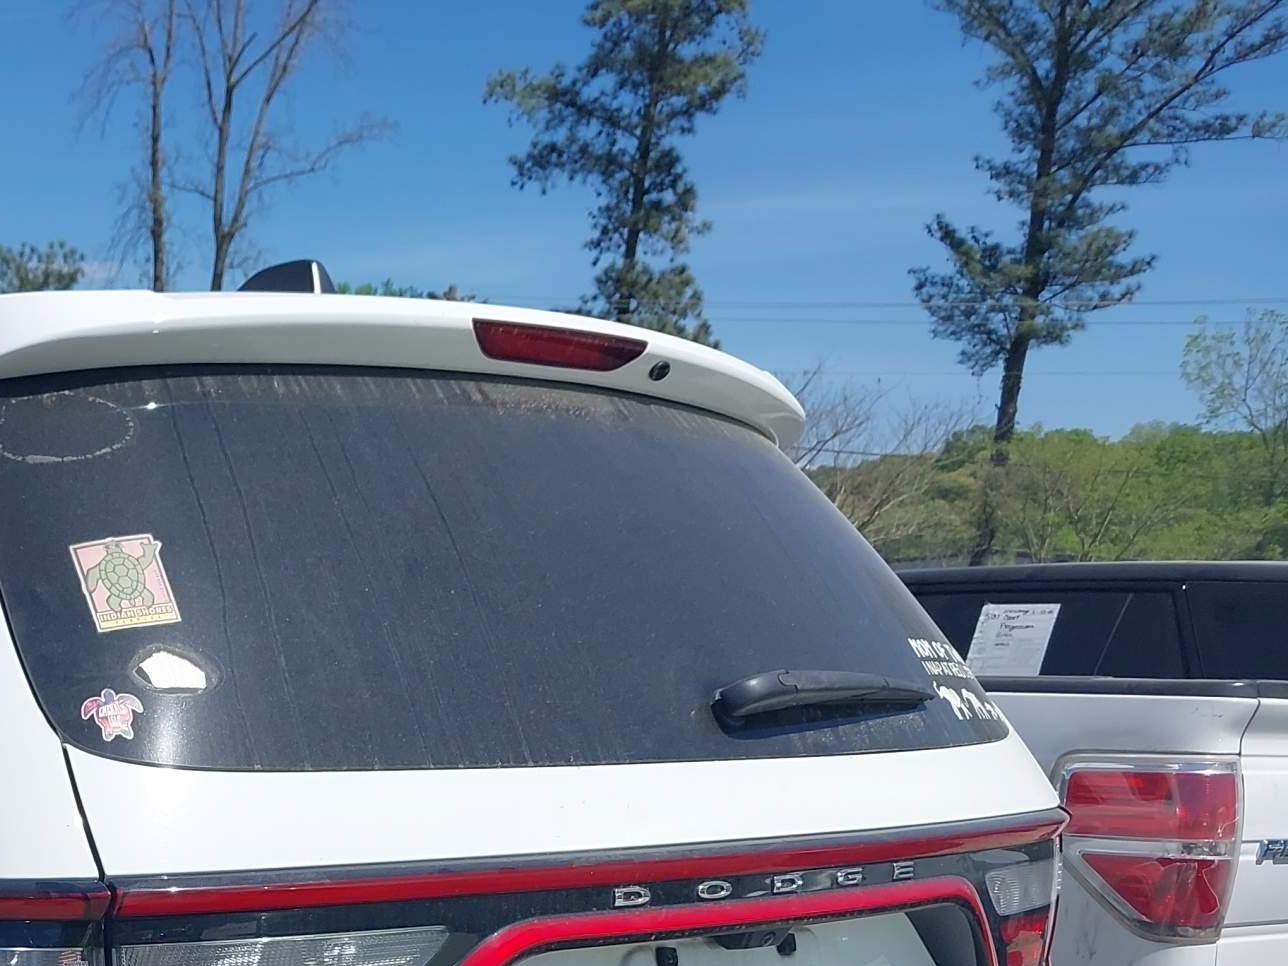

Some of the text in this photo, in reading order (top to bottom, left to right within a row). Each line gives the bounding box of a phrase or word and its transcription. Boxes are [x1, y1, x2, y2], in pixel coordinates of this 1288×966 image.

[99, 608, 135, 623] INDIAN
[136, 603, 174, 617] SHORES
[613, 862, 913, 907] DODGE
